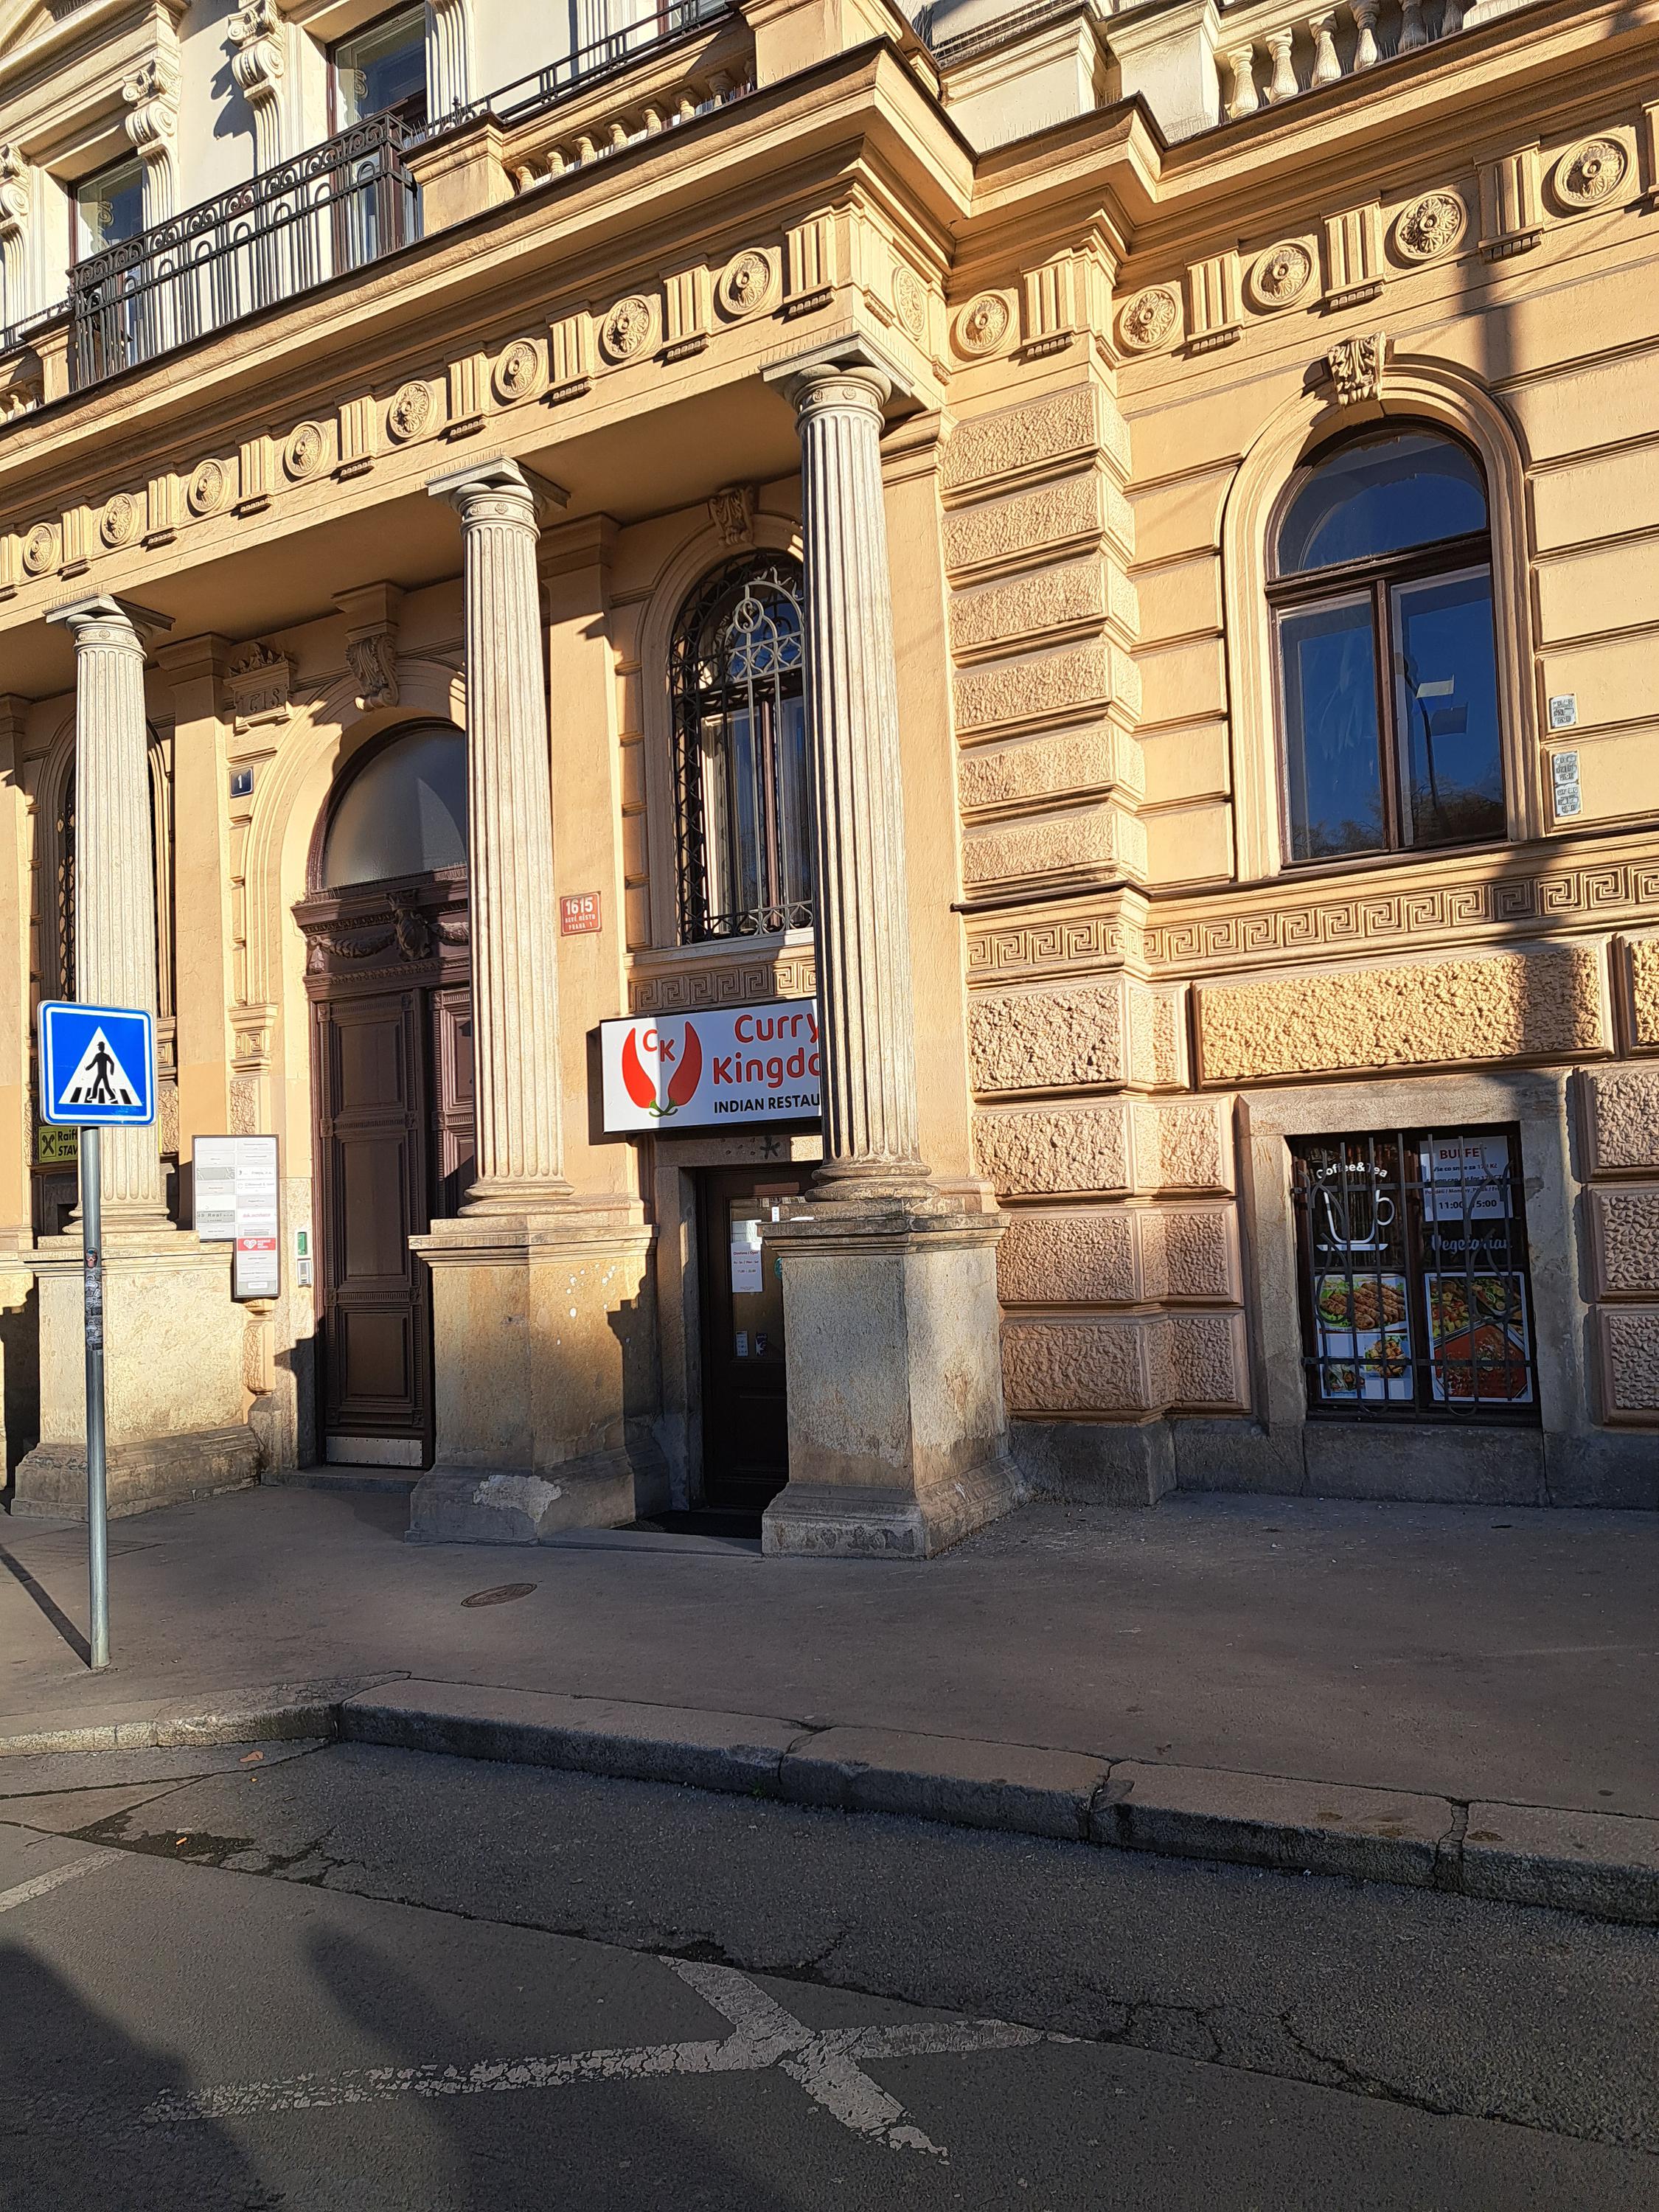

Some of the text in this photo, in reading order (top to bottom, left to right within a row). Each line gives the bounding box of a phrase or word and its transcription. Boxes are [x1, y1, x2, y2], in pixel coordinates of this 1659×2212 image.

[237, 774, 243, 789] 1
[566, 896, 594, 915] 1615
[568, 922, 585, 931] PRAHA
[734, 1013, 819, 1043] Curry
[714, 1097, 765, 1113] INDIAN
